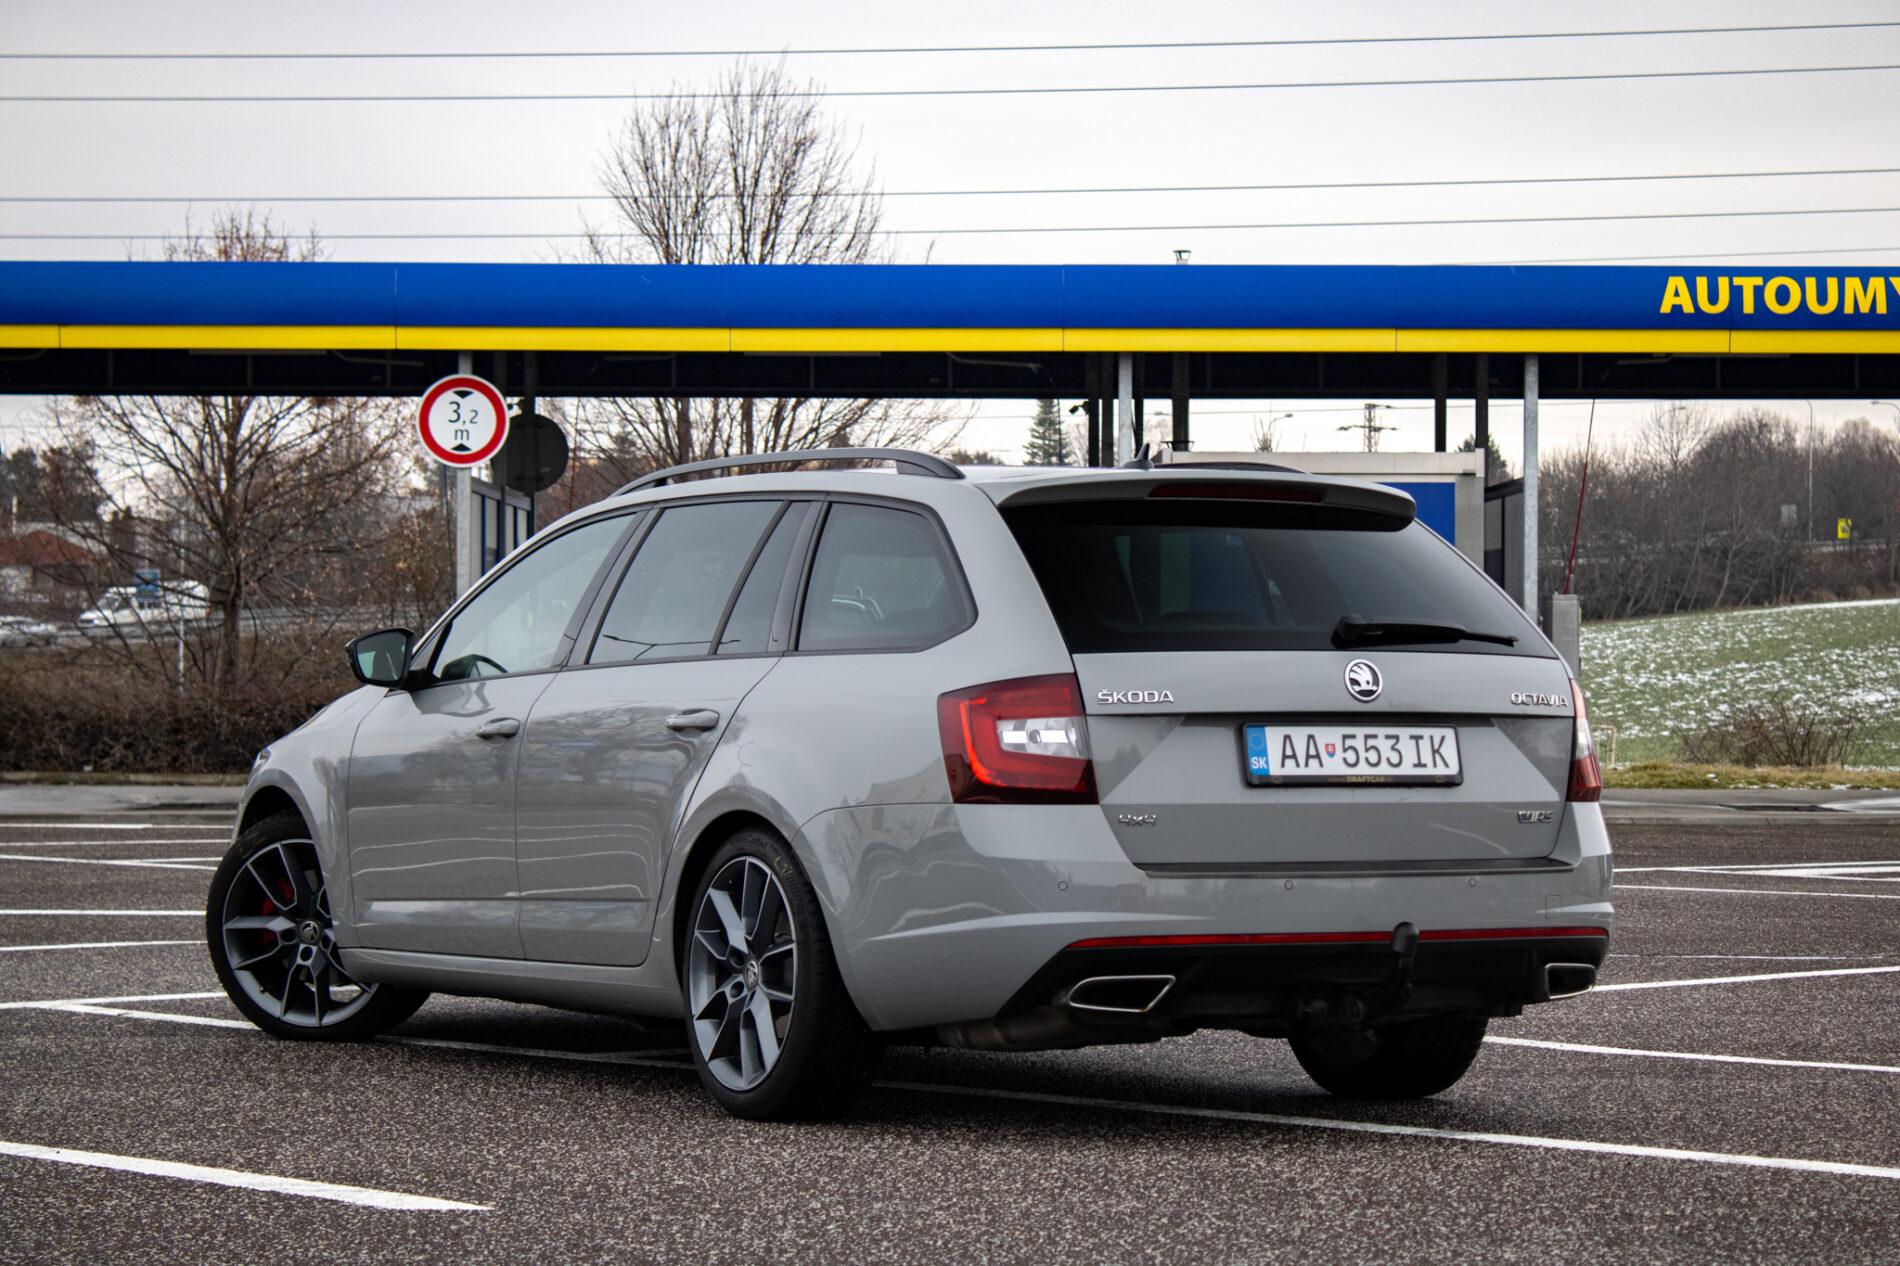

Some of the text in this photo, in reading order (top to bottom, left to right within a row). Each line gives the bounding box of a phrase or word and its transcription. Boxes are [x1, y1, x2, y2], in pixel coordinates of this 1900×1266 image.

[447, 401, 479, 426] 3,2
[454, 428, 470, 441] m
[1097, 688, 1175, 704] ŠKODA
[1510, 692, 1569, 707] OCTAVIA
[1280, 734, 1450, 769] AA 553IK
[1251, 756, 1268, 769] SK
